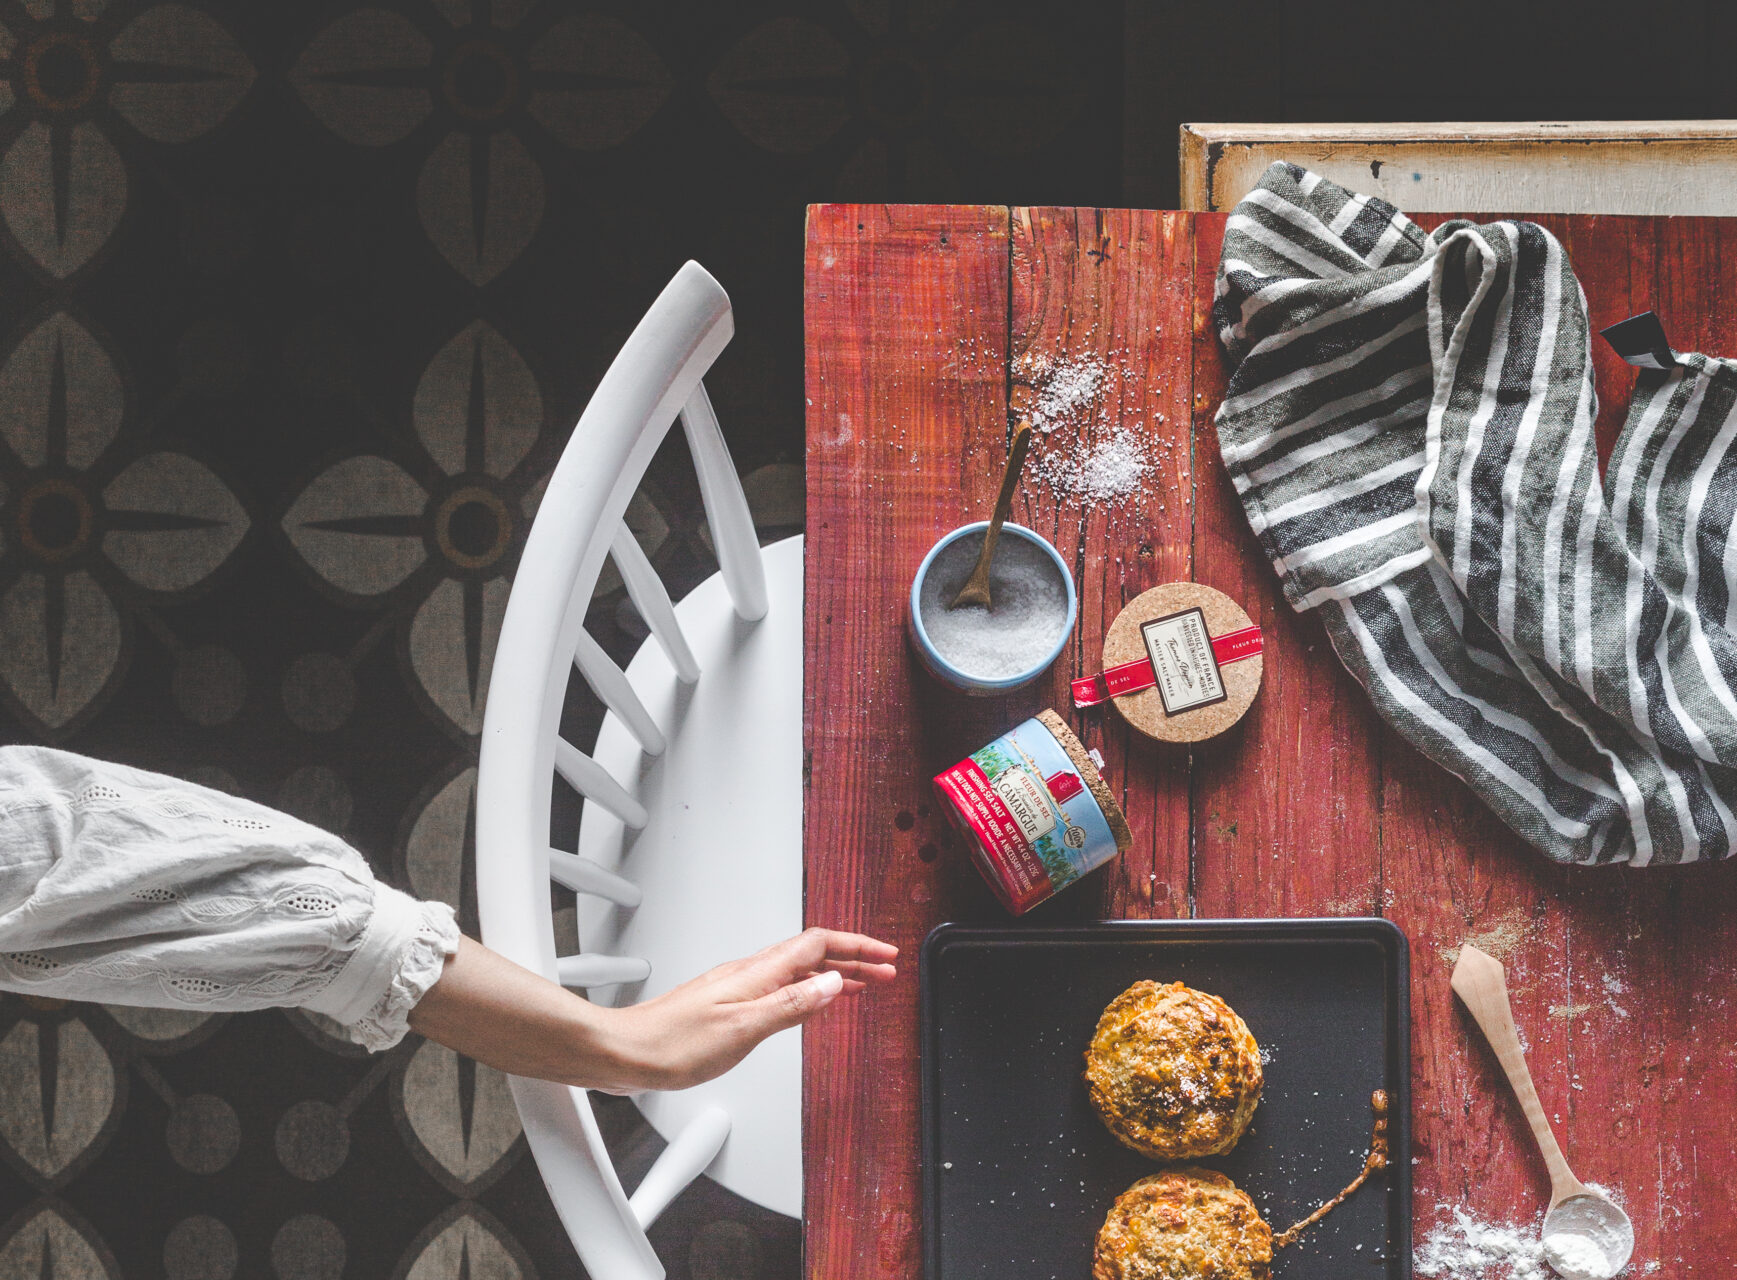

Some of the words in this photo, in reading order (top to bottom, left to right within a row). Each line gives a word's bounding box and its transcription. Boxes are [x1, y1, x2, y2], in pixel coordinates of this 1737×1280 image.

[1189, 618, 1204, 651] PRODUCT
[1153, 639, 1164, 661] MASTER
[1160, 663, 1169, 677] SALT
[1165, 678, 1175, 697] MAKER
[1199, 653, 1207, 662] OF
[1202, 663, 1216, 691] FRANCE
[966, 769, 988, 793] FINISHING
[983, 791, 995, 803] SEA
[991, 802, 1006, 818] SALT
[1000, 785, 1038, 836] CAMARGUE
[1020, 776, 1037, 798] FLEUR
[1033, 796, 1044, 808] DE
[1039, 806, 1051, 820] SEL
[955, 775, 966, 785] SALT
[961, 782, 973, 795] DOES
[969, 792, 980, 804] NOT
[976, 802, 992, 821] SUPPLY
[987, 819, 1004, 839] IODIDE
[1002, 843, 1023, 871] NECESSARY
[1004, 822, 1015, 835] NET
[1012, 834, 1021, 844] WT
[1022, 852, 1031, 862] OZ
